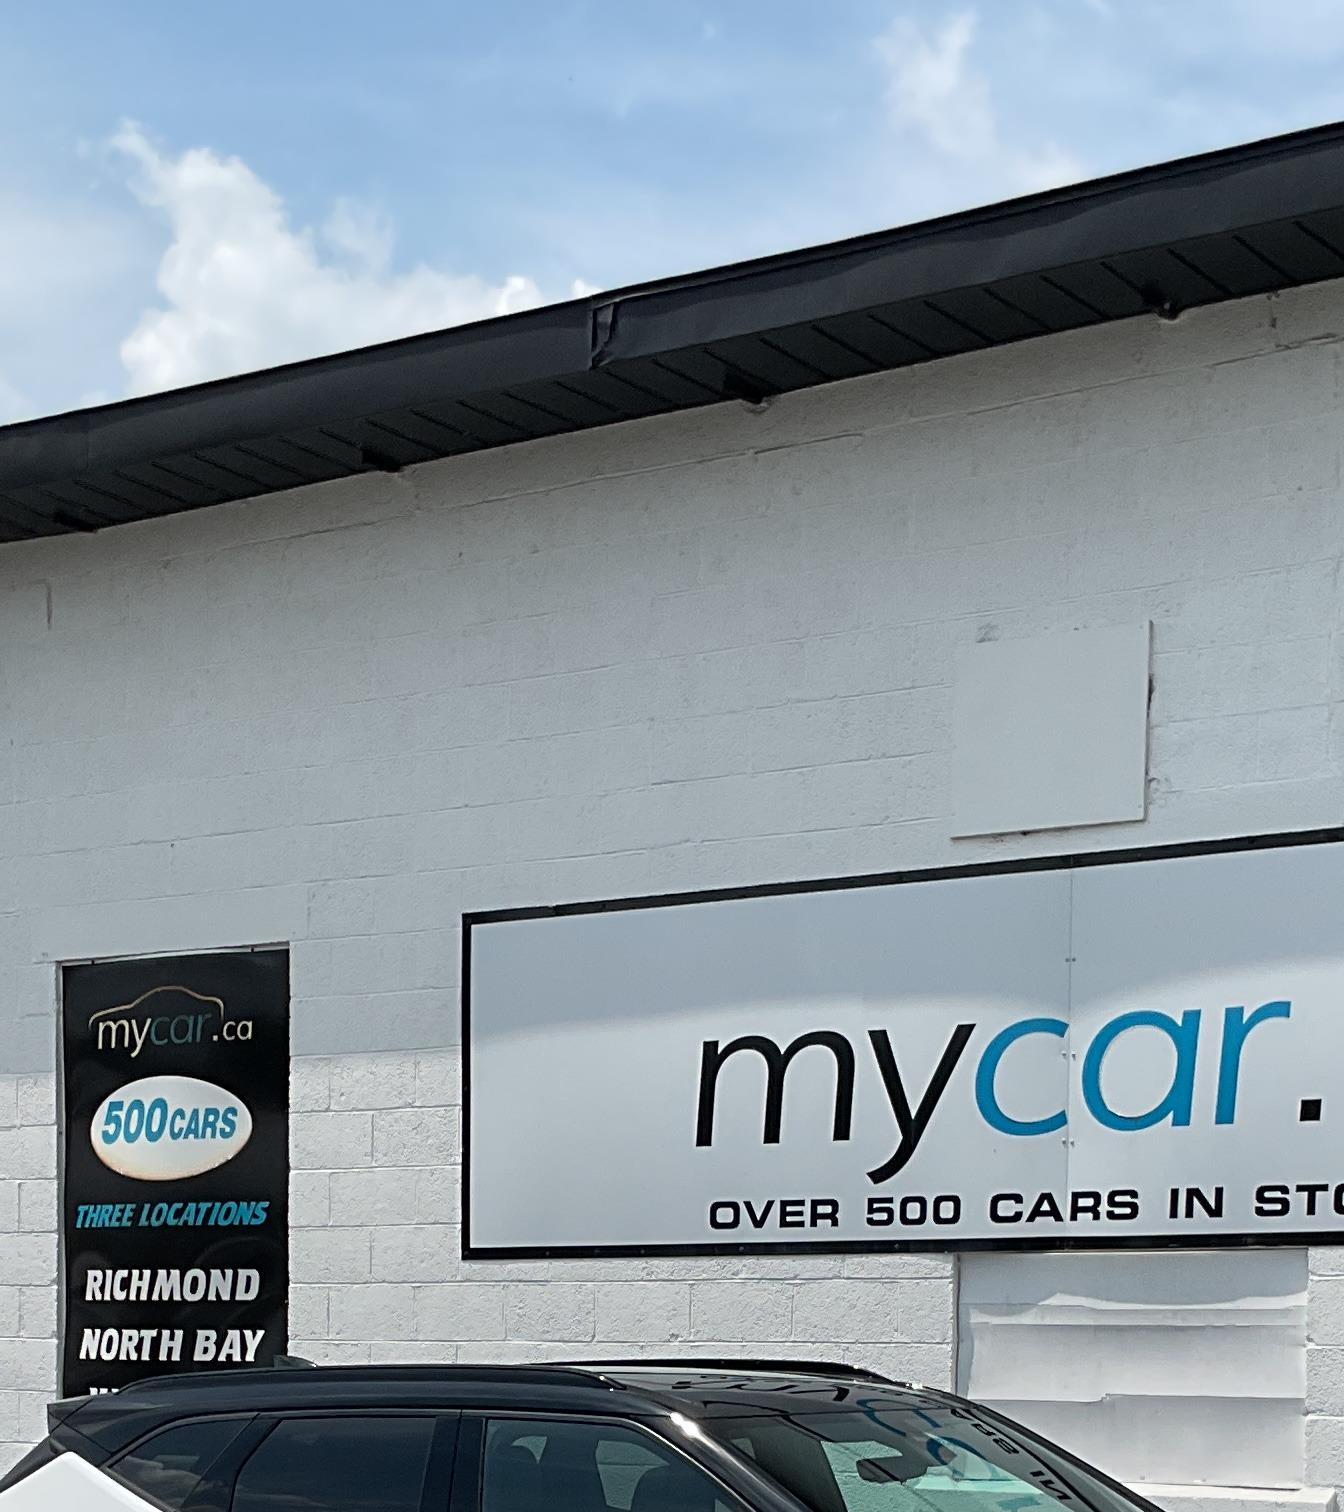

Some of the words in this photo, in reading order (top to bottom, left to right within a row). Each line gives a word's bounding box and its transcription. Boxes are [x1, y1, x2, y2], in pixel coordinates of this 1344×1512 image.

[97, 1010, 253, 1058] mycar.ca
[76, 1204, 134, 1229] THREE
[138, 1201, 271, 1227] LOCATIONS
[709, 1199, 840, 1230] OVER
[865, 1194, 962, 1228] 500
[988, 1189, 1140, 1224] CARS
[1168, 1186, 1224, 1219] IN
[85, 1268, 260, 1302] RICHMOND
[79, 1328, 185, 1362] NORTH
[193, 1328, 266, 1363] BAY
